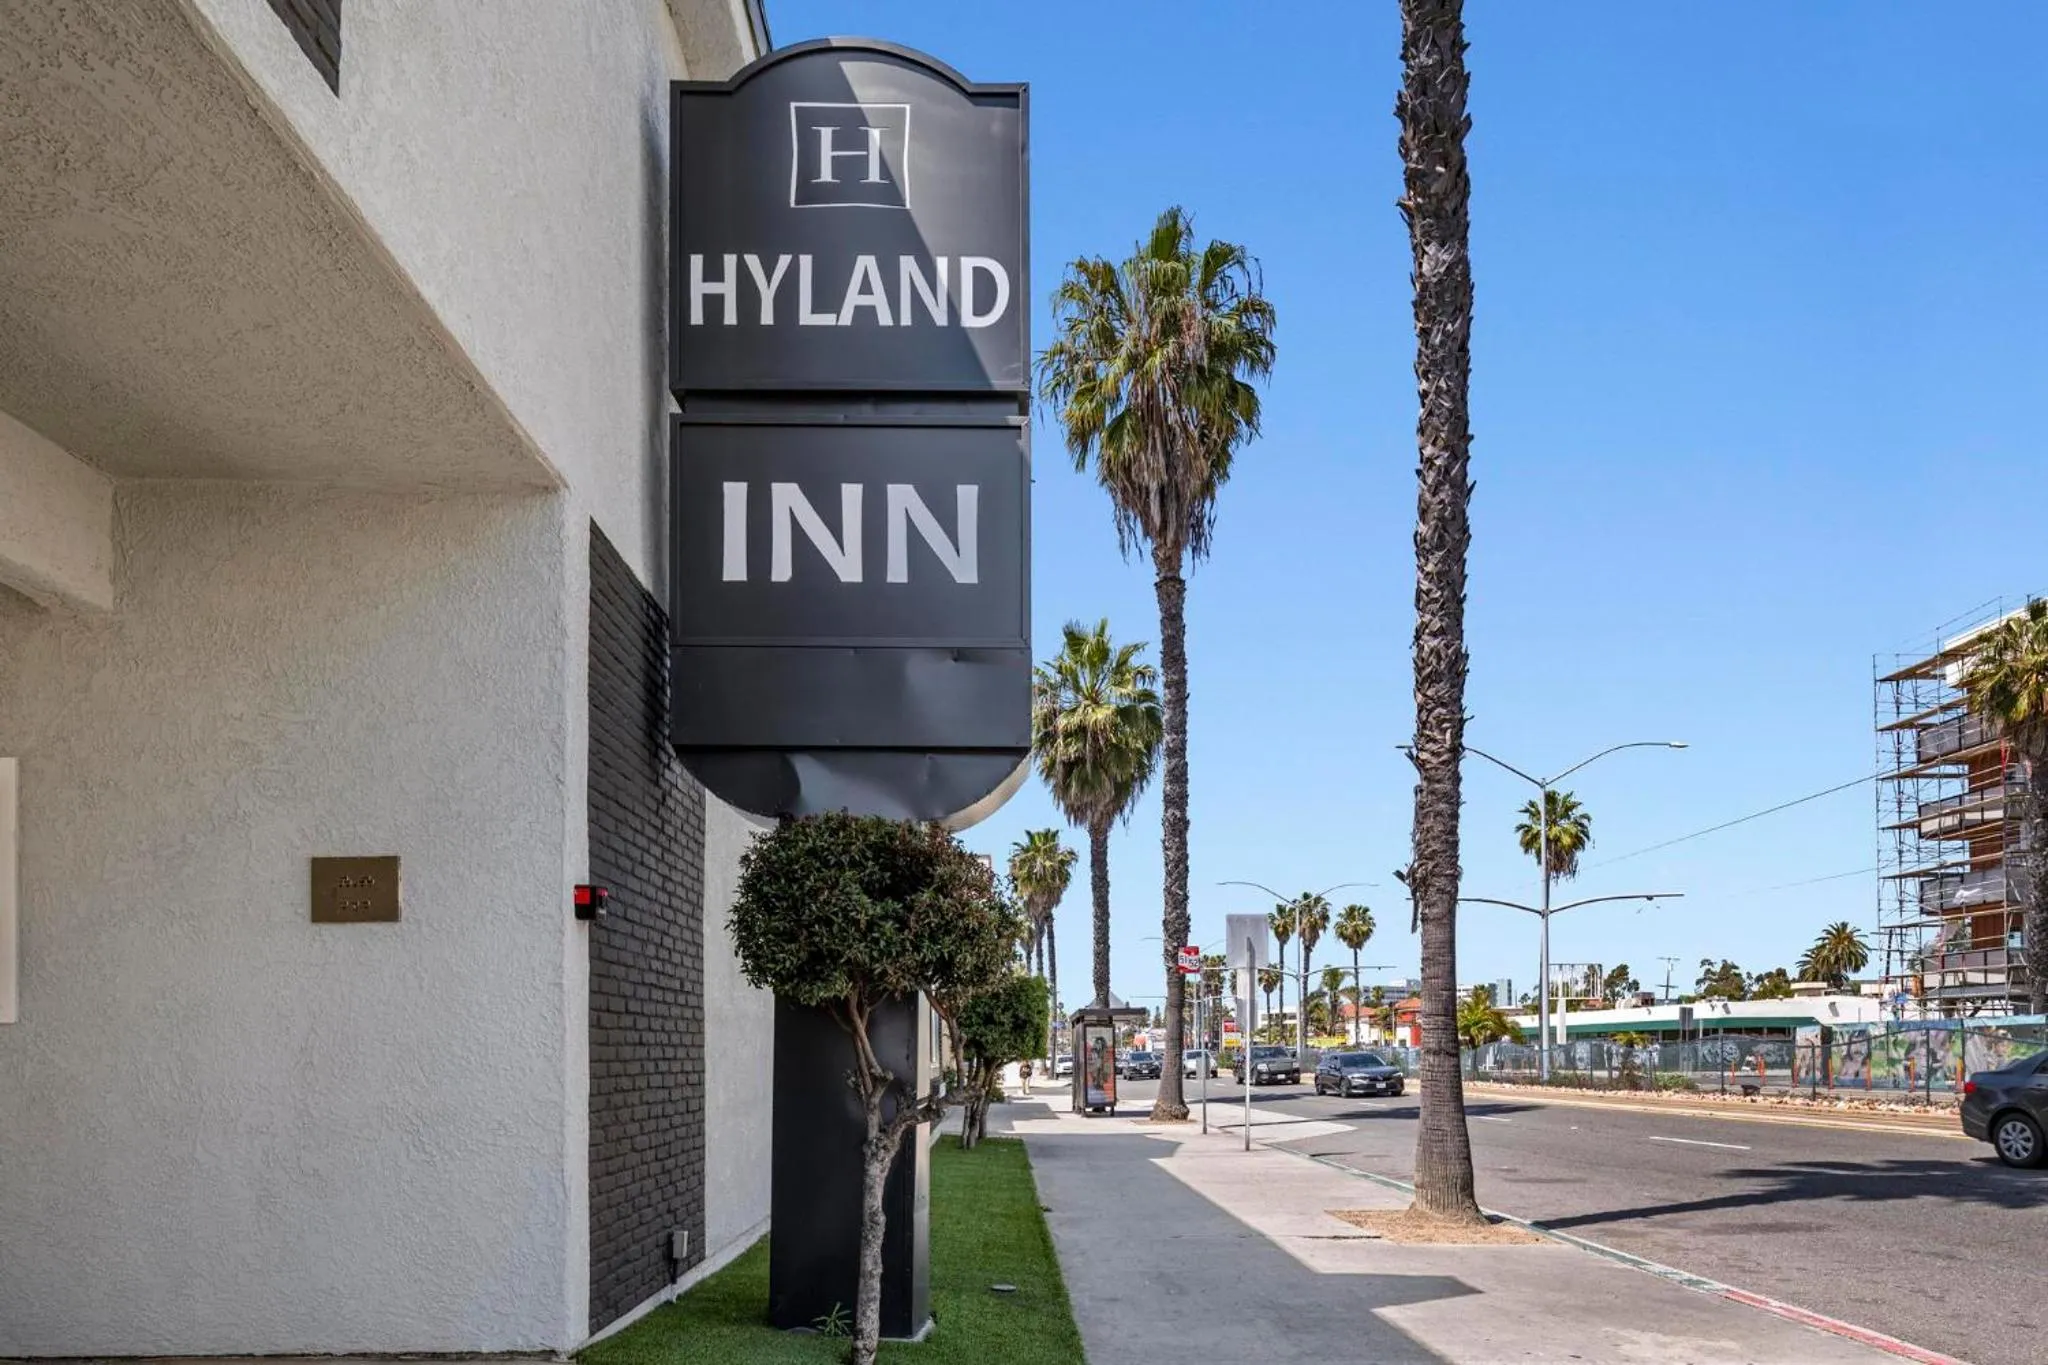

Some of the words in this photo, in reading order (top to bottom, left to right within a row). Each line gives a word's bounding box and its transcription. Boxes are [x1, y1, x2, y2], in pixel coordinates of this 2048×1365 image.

[811, 126, 890, 184] H
[689, 253, 1010, 328] HYLAND
[722, 481, 979, 584] INN
